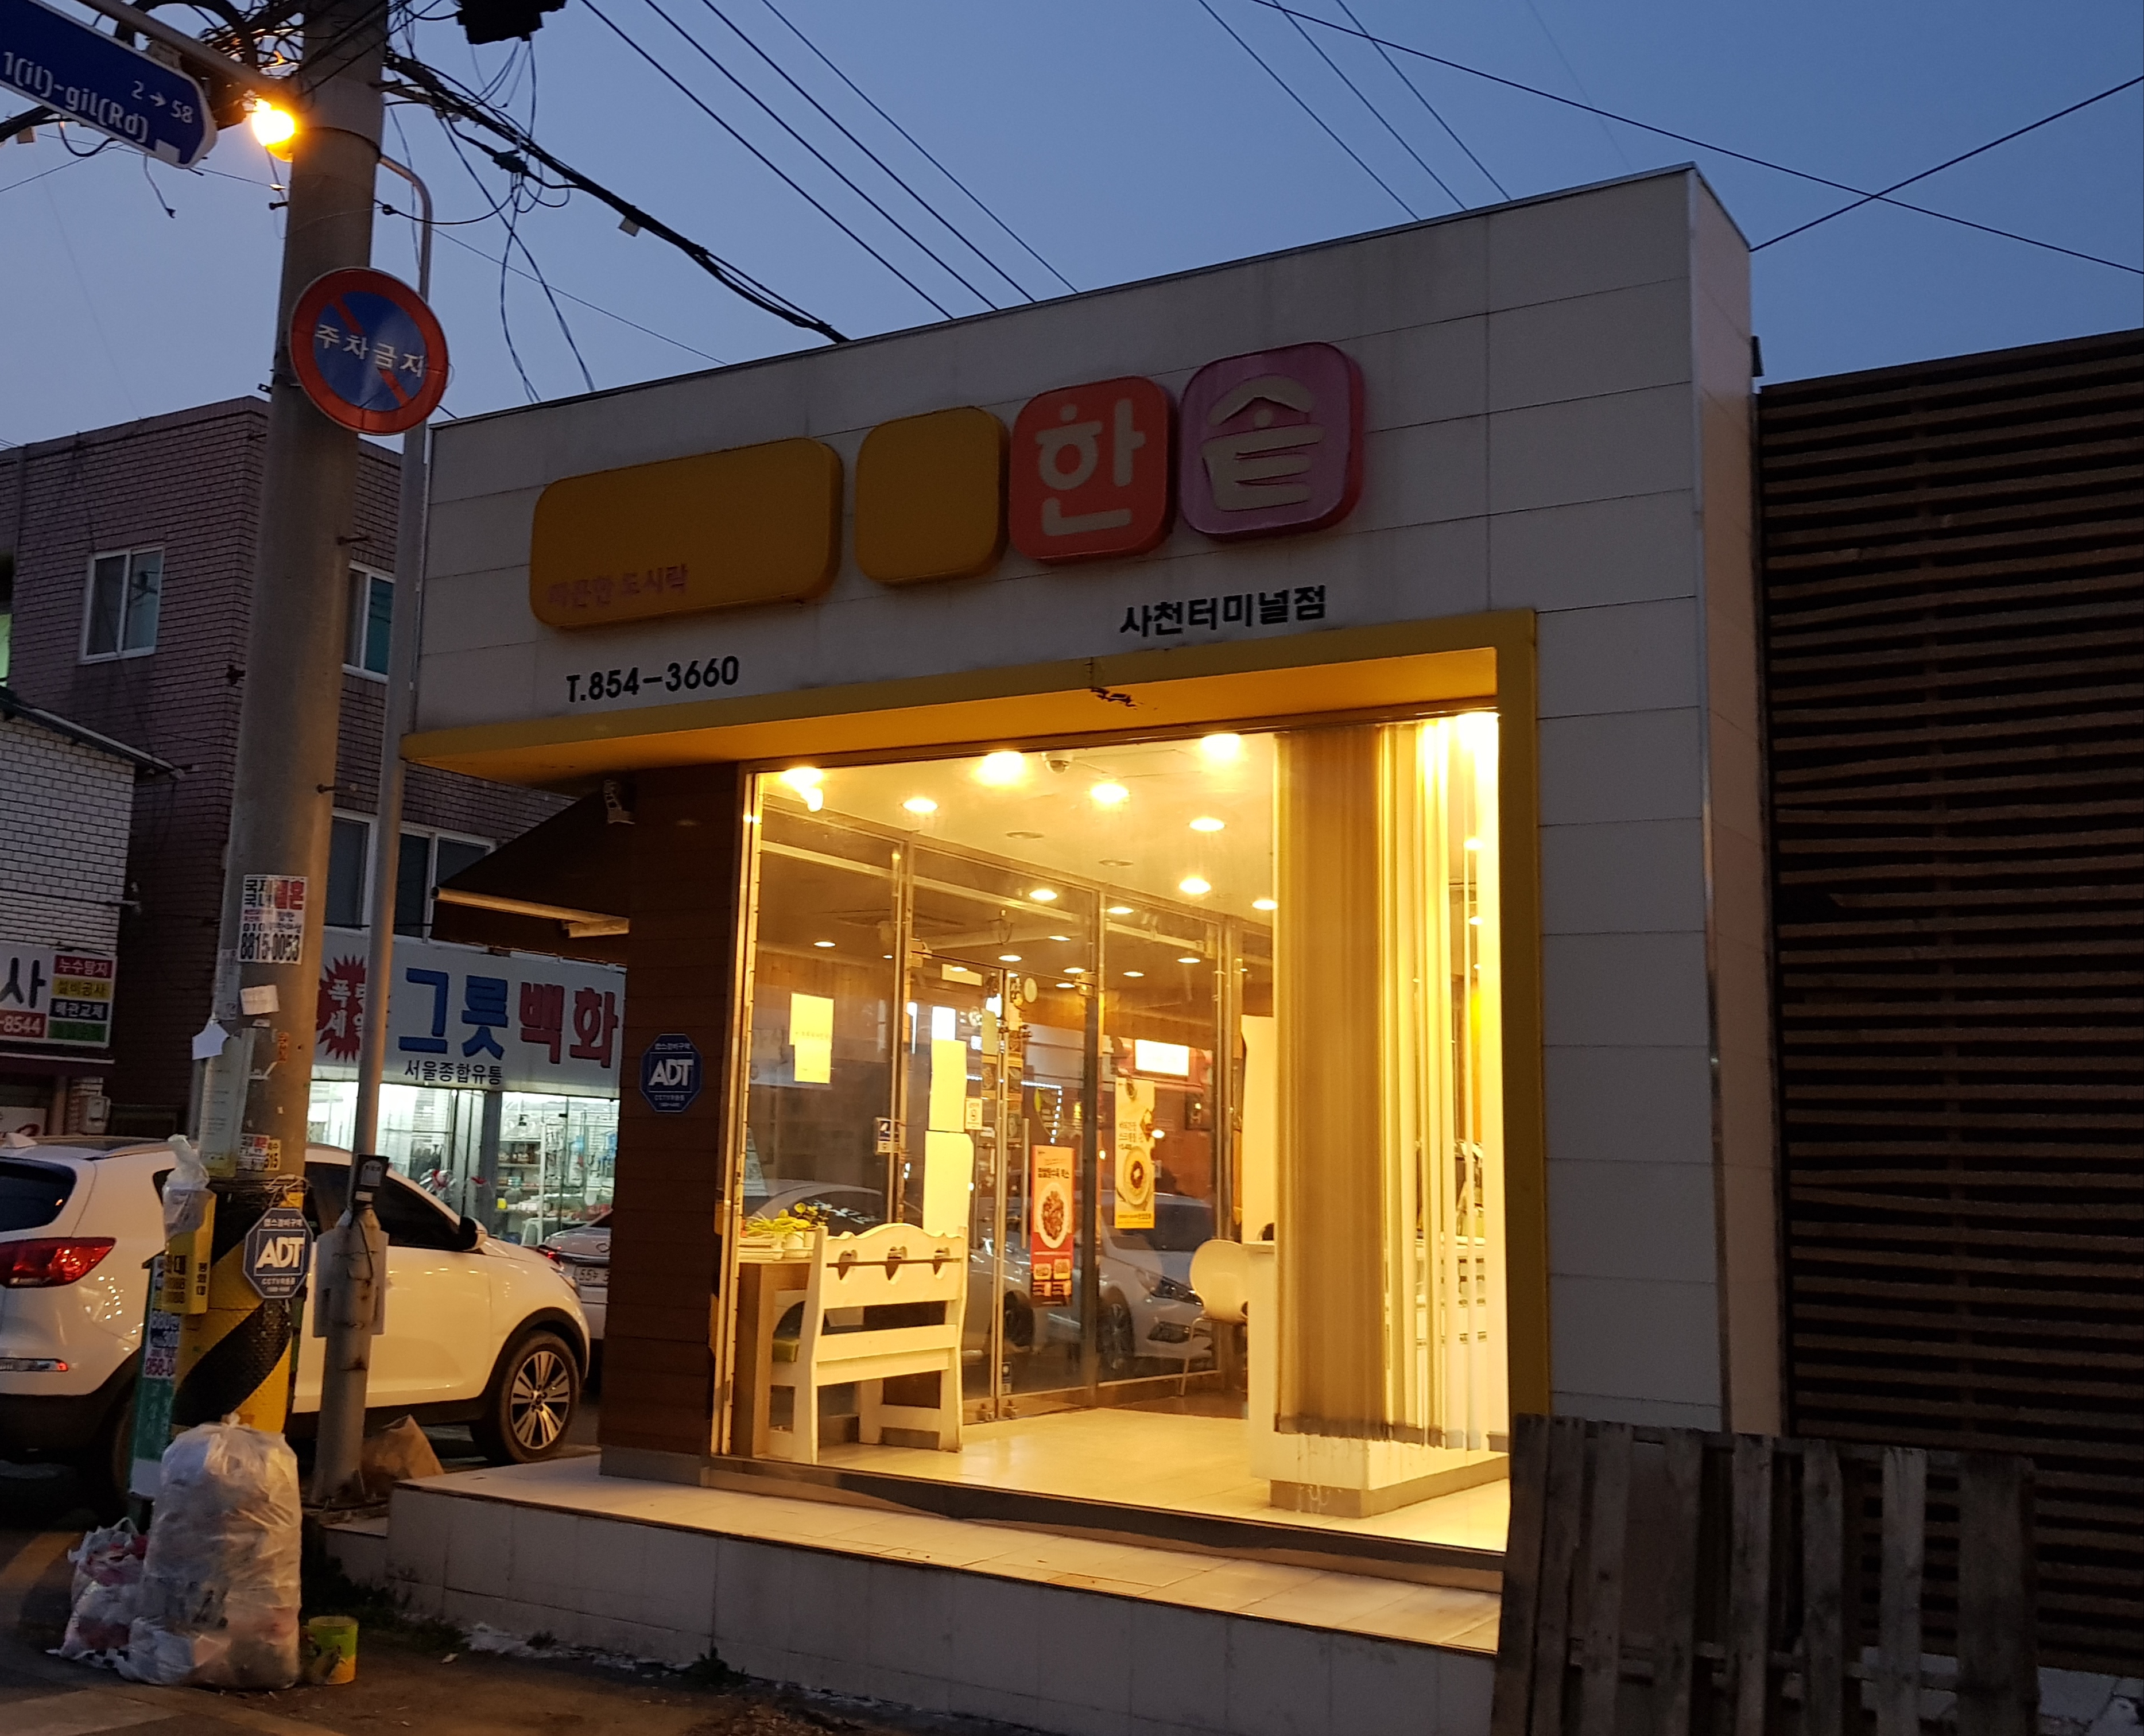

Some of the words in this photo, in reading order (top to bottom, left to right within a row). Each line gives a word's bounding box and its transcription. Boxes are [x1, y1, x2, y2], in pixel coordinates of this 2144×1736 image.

[130, 80, 144, 100] 2
[171, 100, 194, 124] 58
[315, 324, 425, 378] 주차금지
[1119, 584, 1327, 637] 사천터미널점
[404, 1059, 503, 1085] 서울종합유통
[648, 1059, 694, 1086] ADT
[255, 1237, 305, 1268] ADT
